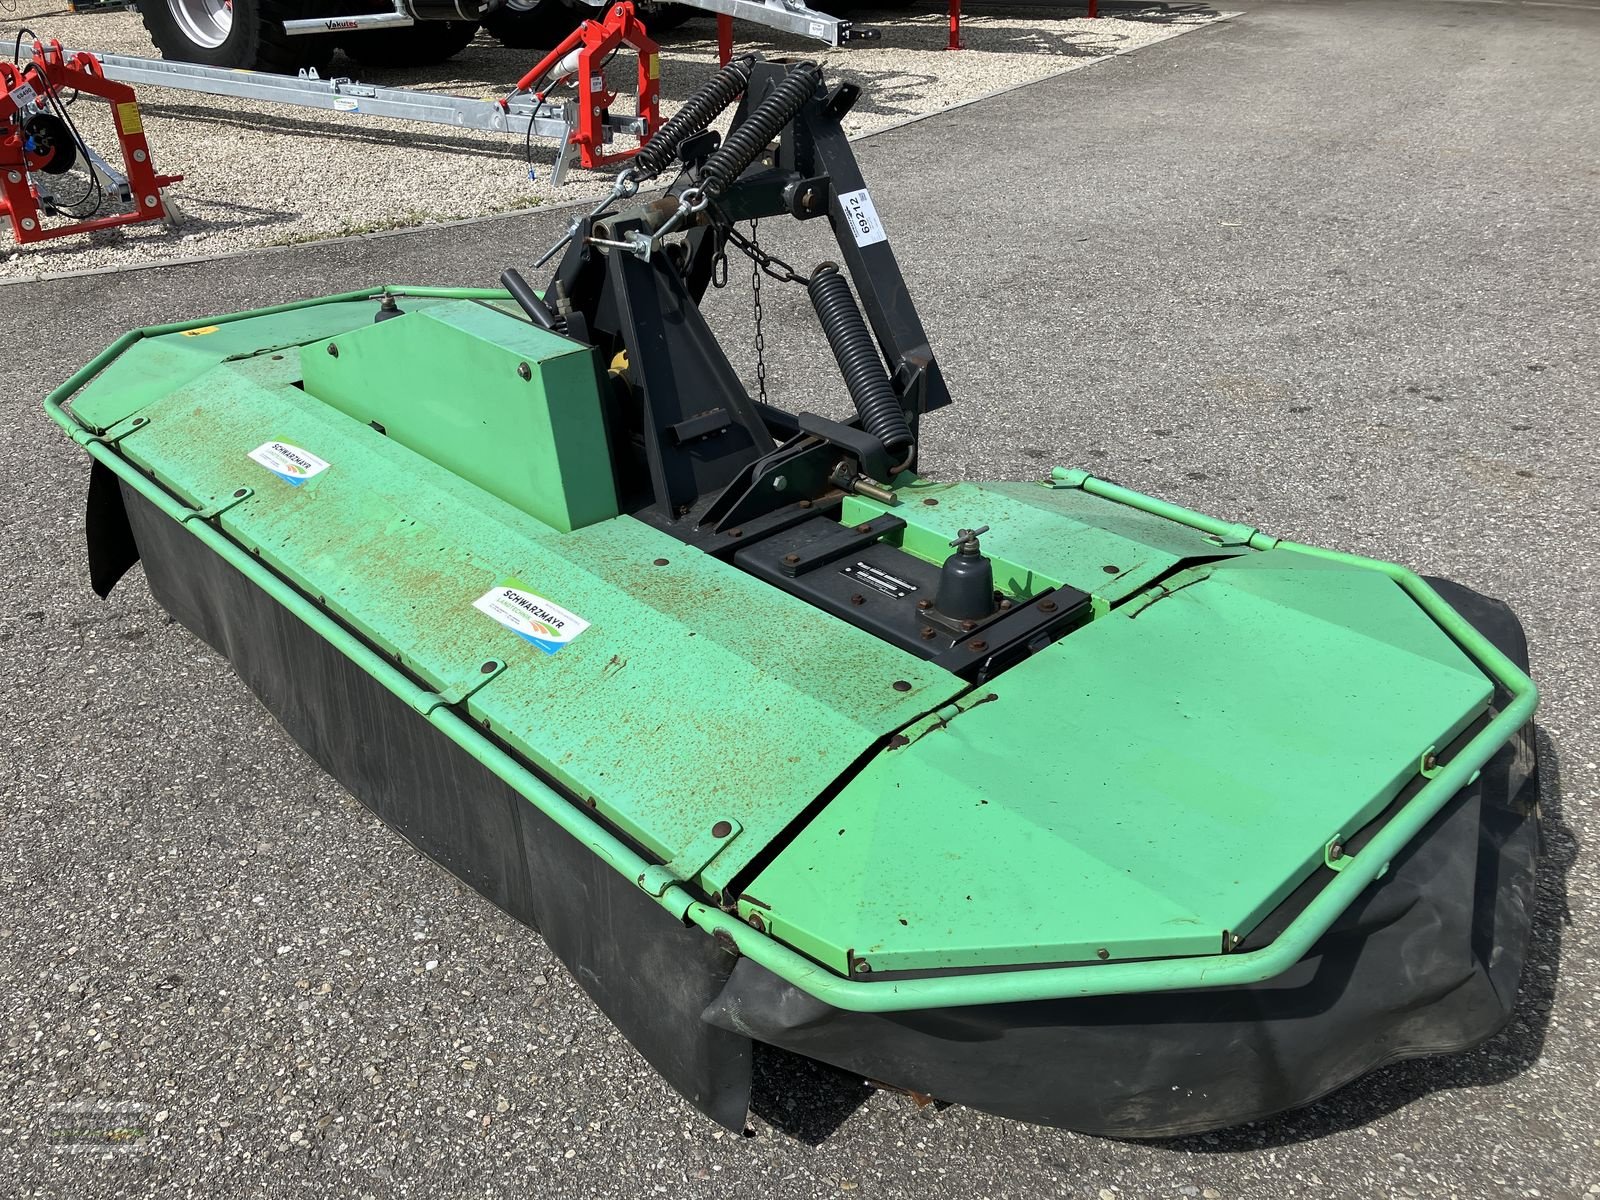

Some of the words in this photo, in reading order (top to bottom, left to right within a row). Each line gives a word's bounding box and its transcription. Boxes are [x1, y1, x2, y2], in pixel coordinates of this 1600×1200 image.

[325, 19, 358, 30] Vakutec
[849, 196, 871, 234] 69212
[271, 443, 312, 469] SCHWARZMAYR
[503, 590, 565, 629] SCHWARZMAYR
